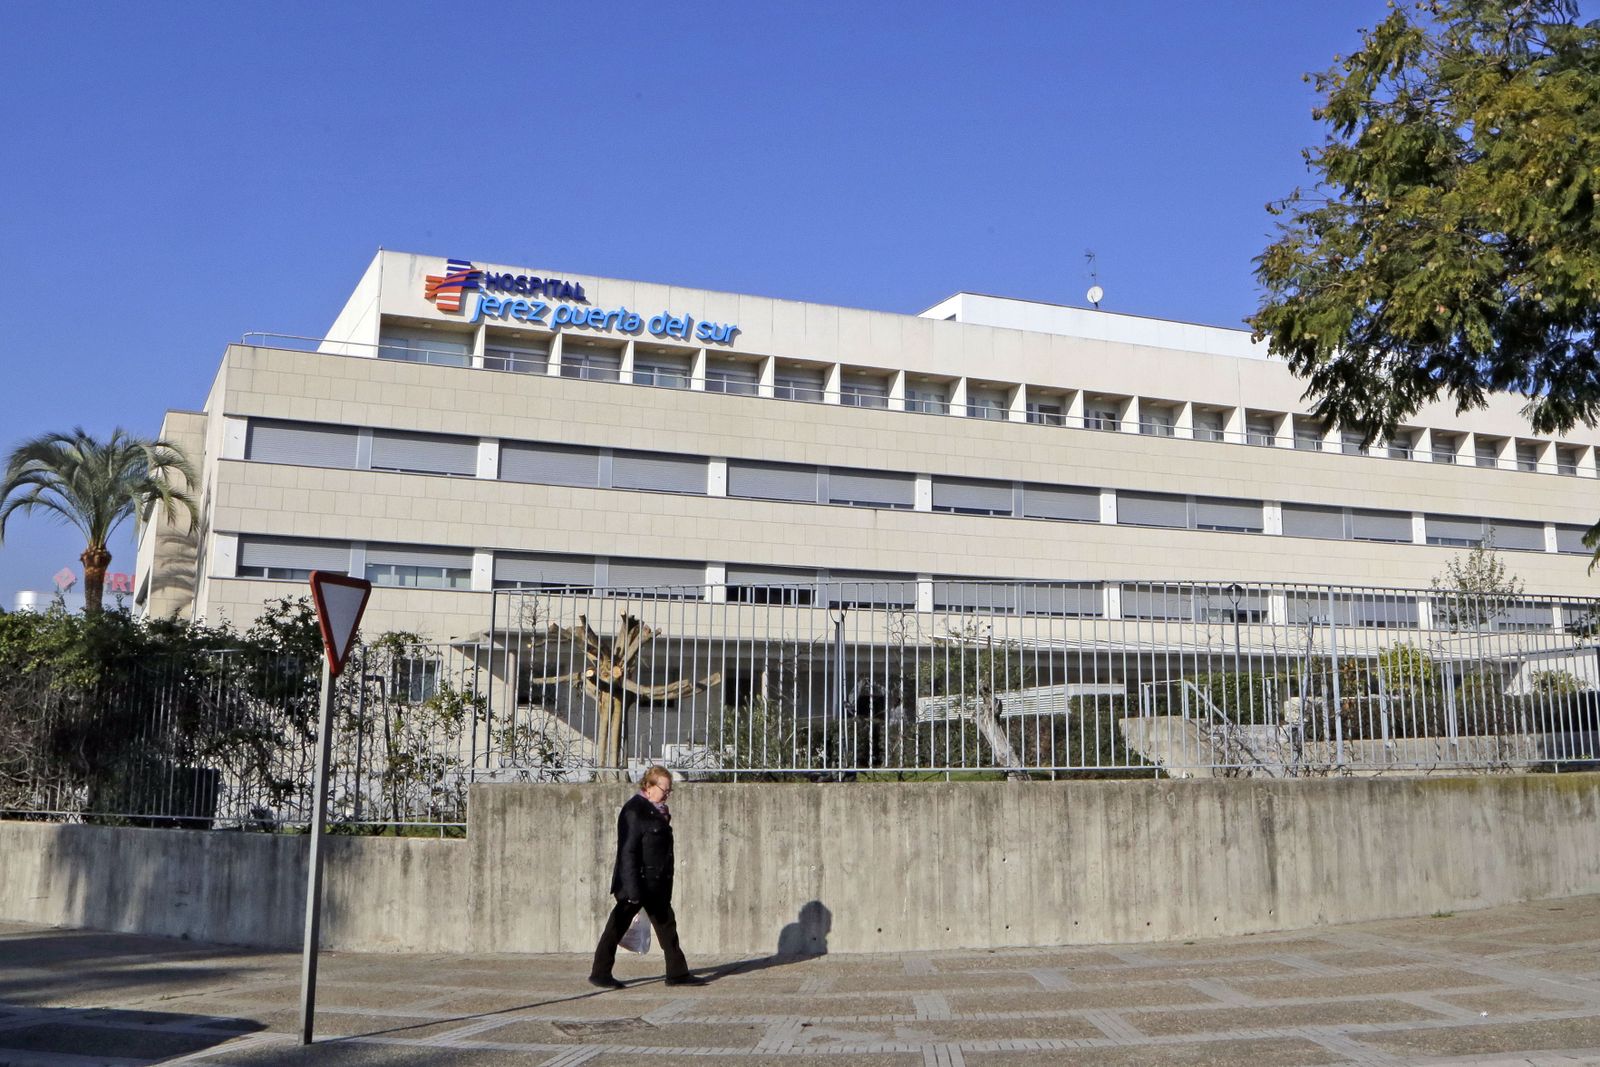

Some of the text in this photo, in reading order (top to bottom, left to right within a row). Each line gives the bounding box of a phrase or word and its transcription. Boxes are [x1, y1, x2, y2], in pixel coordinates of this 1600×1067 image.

[485, 271, 586, 301] HOSPITAL
[469, 287, 738, 344] jerez puerta del sur
